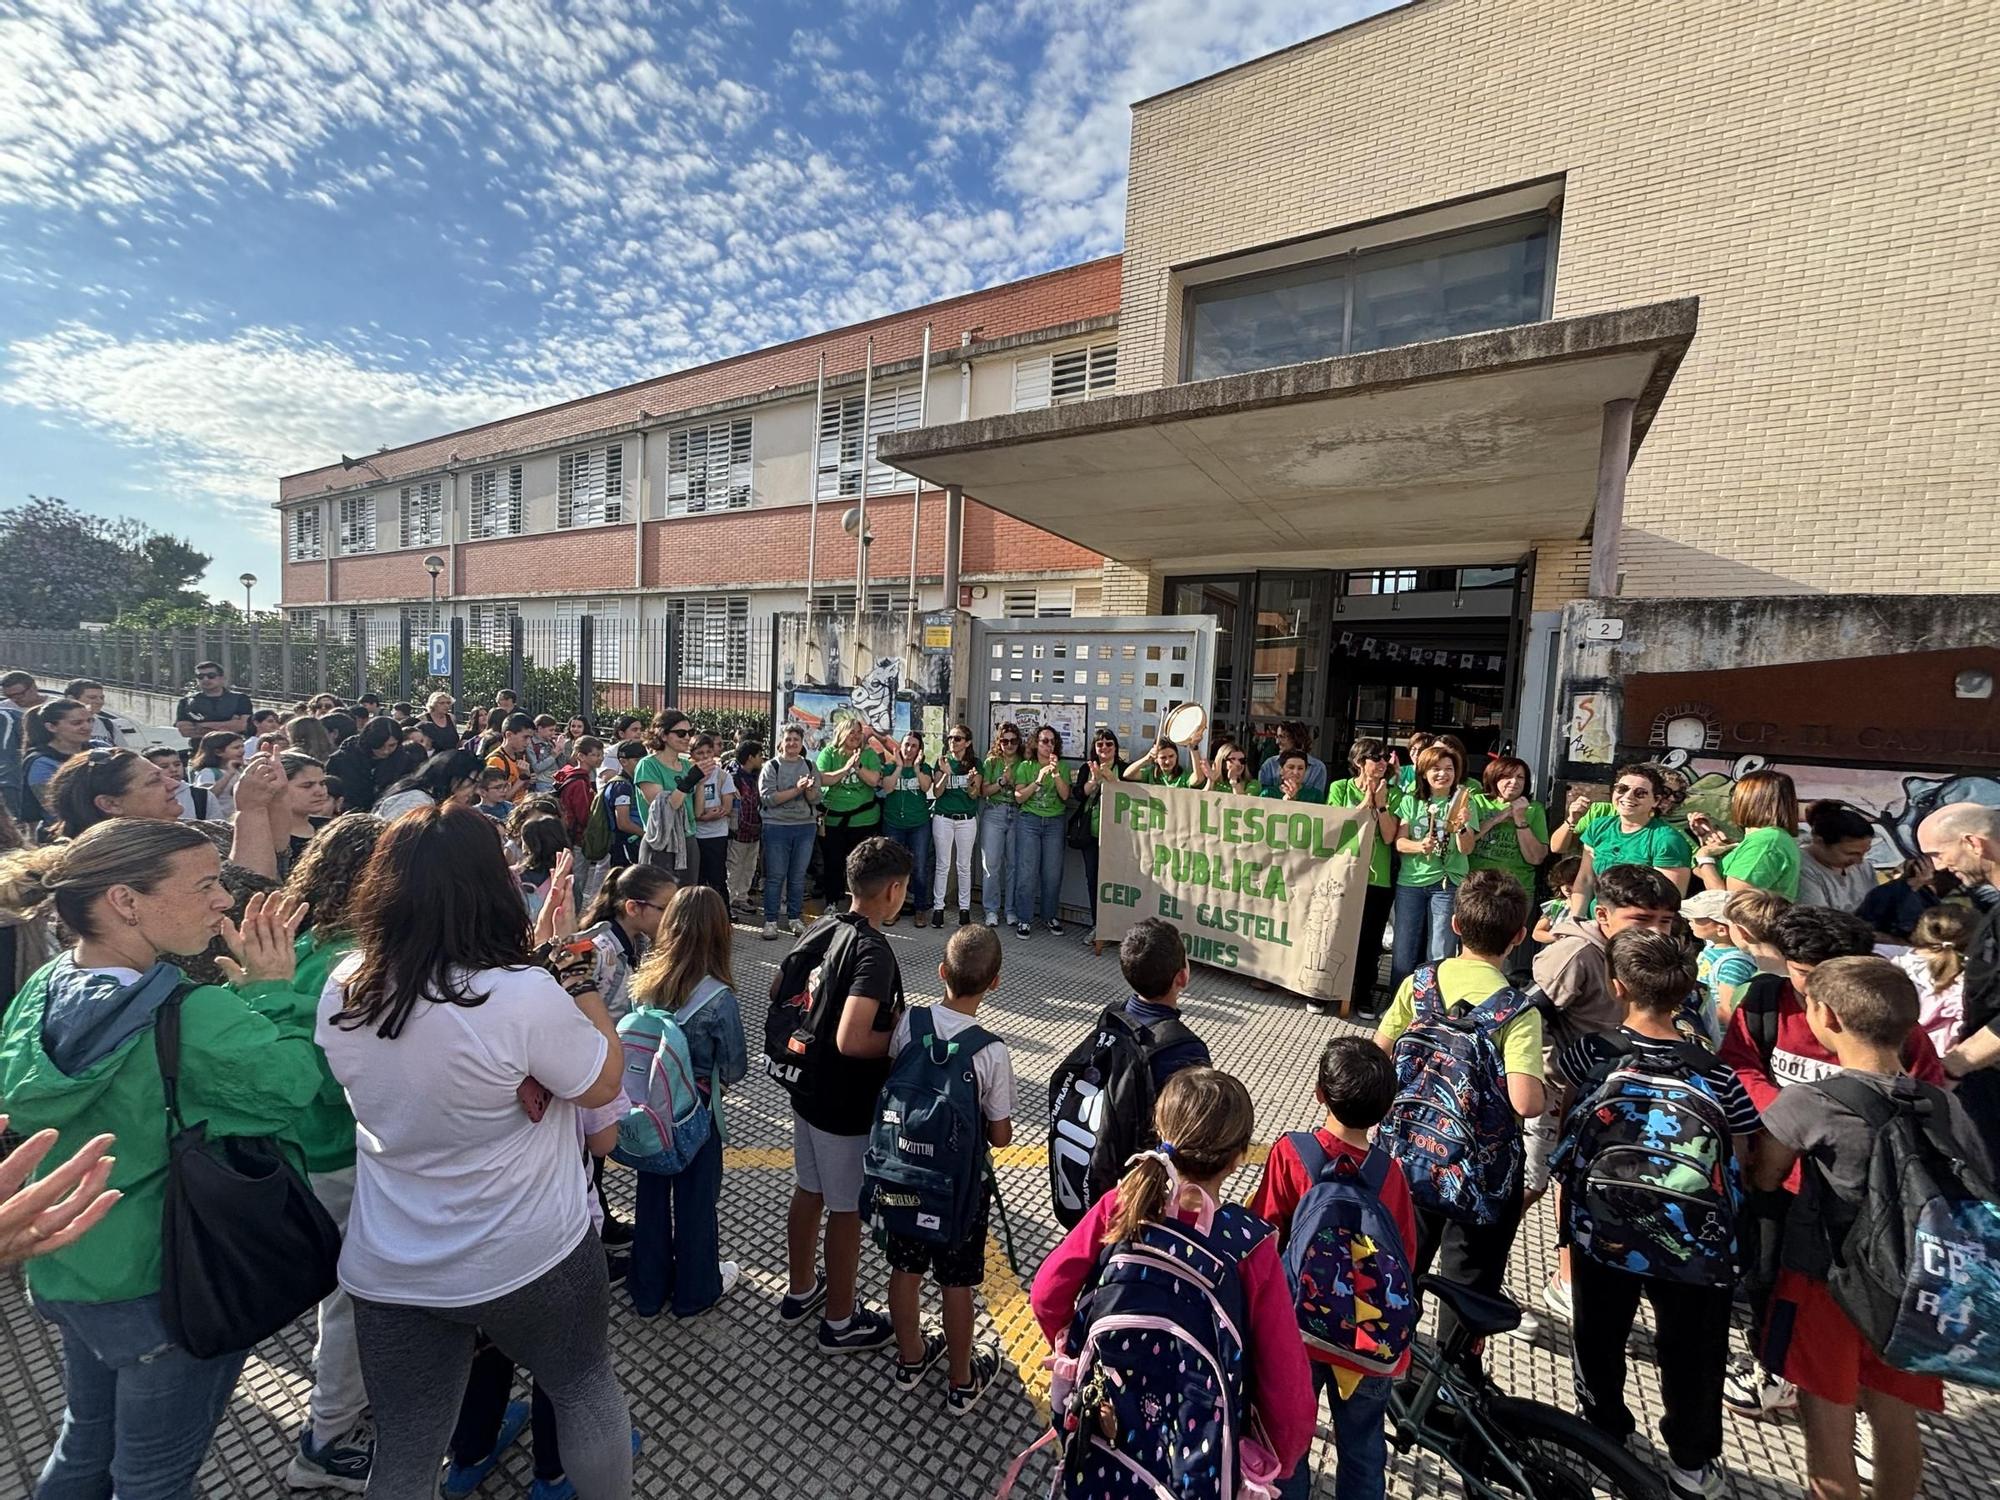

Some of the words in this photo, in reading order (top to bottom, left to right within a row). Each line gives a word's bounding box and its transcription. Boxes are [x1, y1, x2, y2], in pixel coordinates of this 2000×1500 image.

[1600, 623, 1610, 635] 2
[433, 638, 446, 670] P
[1113, 791, 1168, 832] PER
[1152, 842, 1287, 902] PÚBLICA
[1100, 882, 1142, 908] CEIP
[1158, 893, 1184, 921] EL
[1196, 903, 1293, 948] CASTELL
[1180, 932, 1240, 969] OINES
